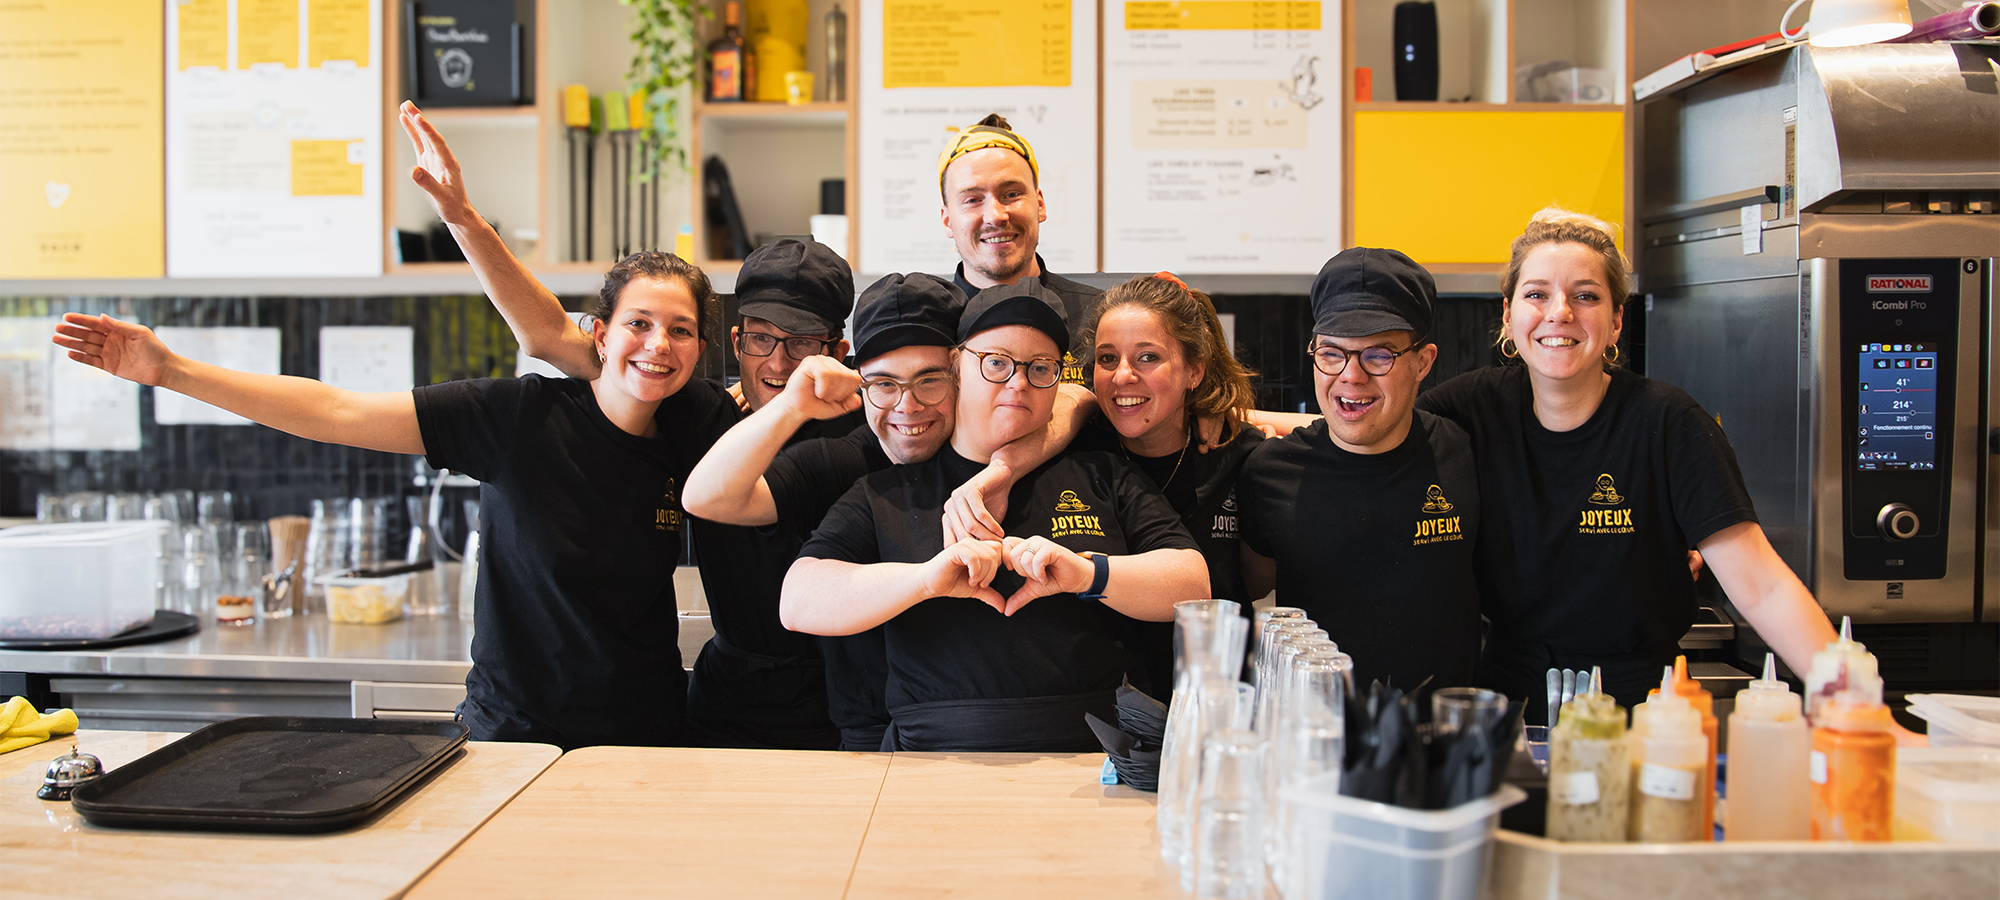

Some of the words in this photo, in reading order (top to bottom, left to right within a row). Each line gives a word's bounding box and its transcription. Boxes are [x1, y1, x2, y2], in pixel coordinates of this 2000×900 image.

[1967, 262, 1974, 271] 6
[1870, 278, 1929, 289] RATIONAL
[1872, 300, 1908, 310] iCombi
[1910, 300, 1927, 310] Pro
[1060, 366, 1084, 380] EUX
[1051, 515, 1102, 532] JOYEUX
[1579, 508, 1633, 527] JOYEUX
[1414, 515, 1461, 538] JOYEUX
